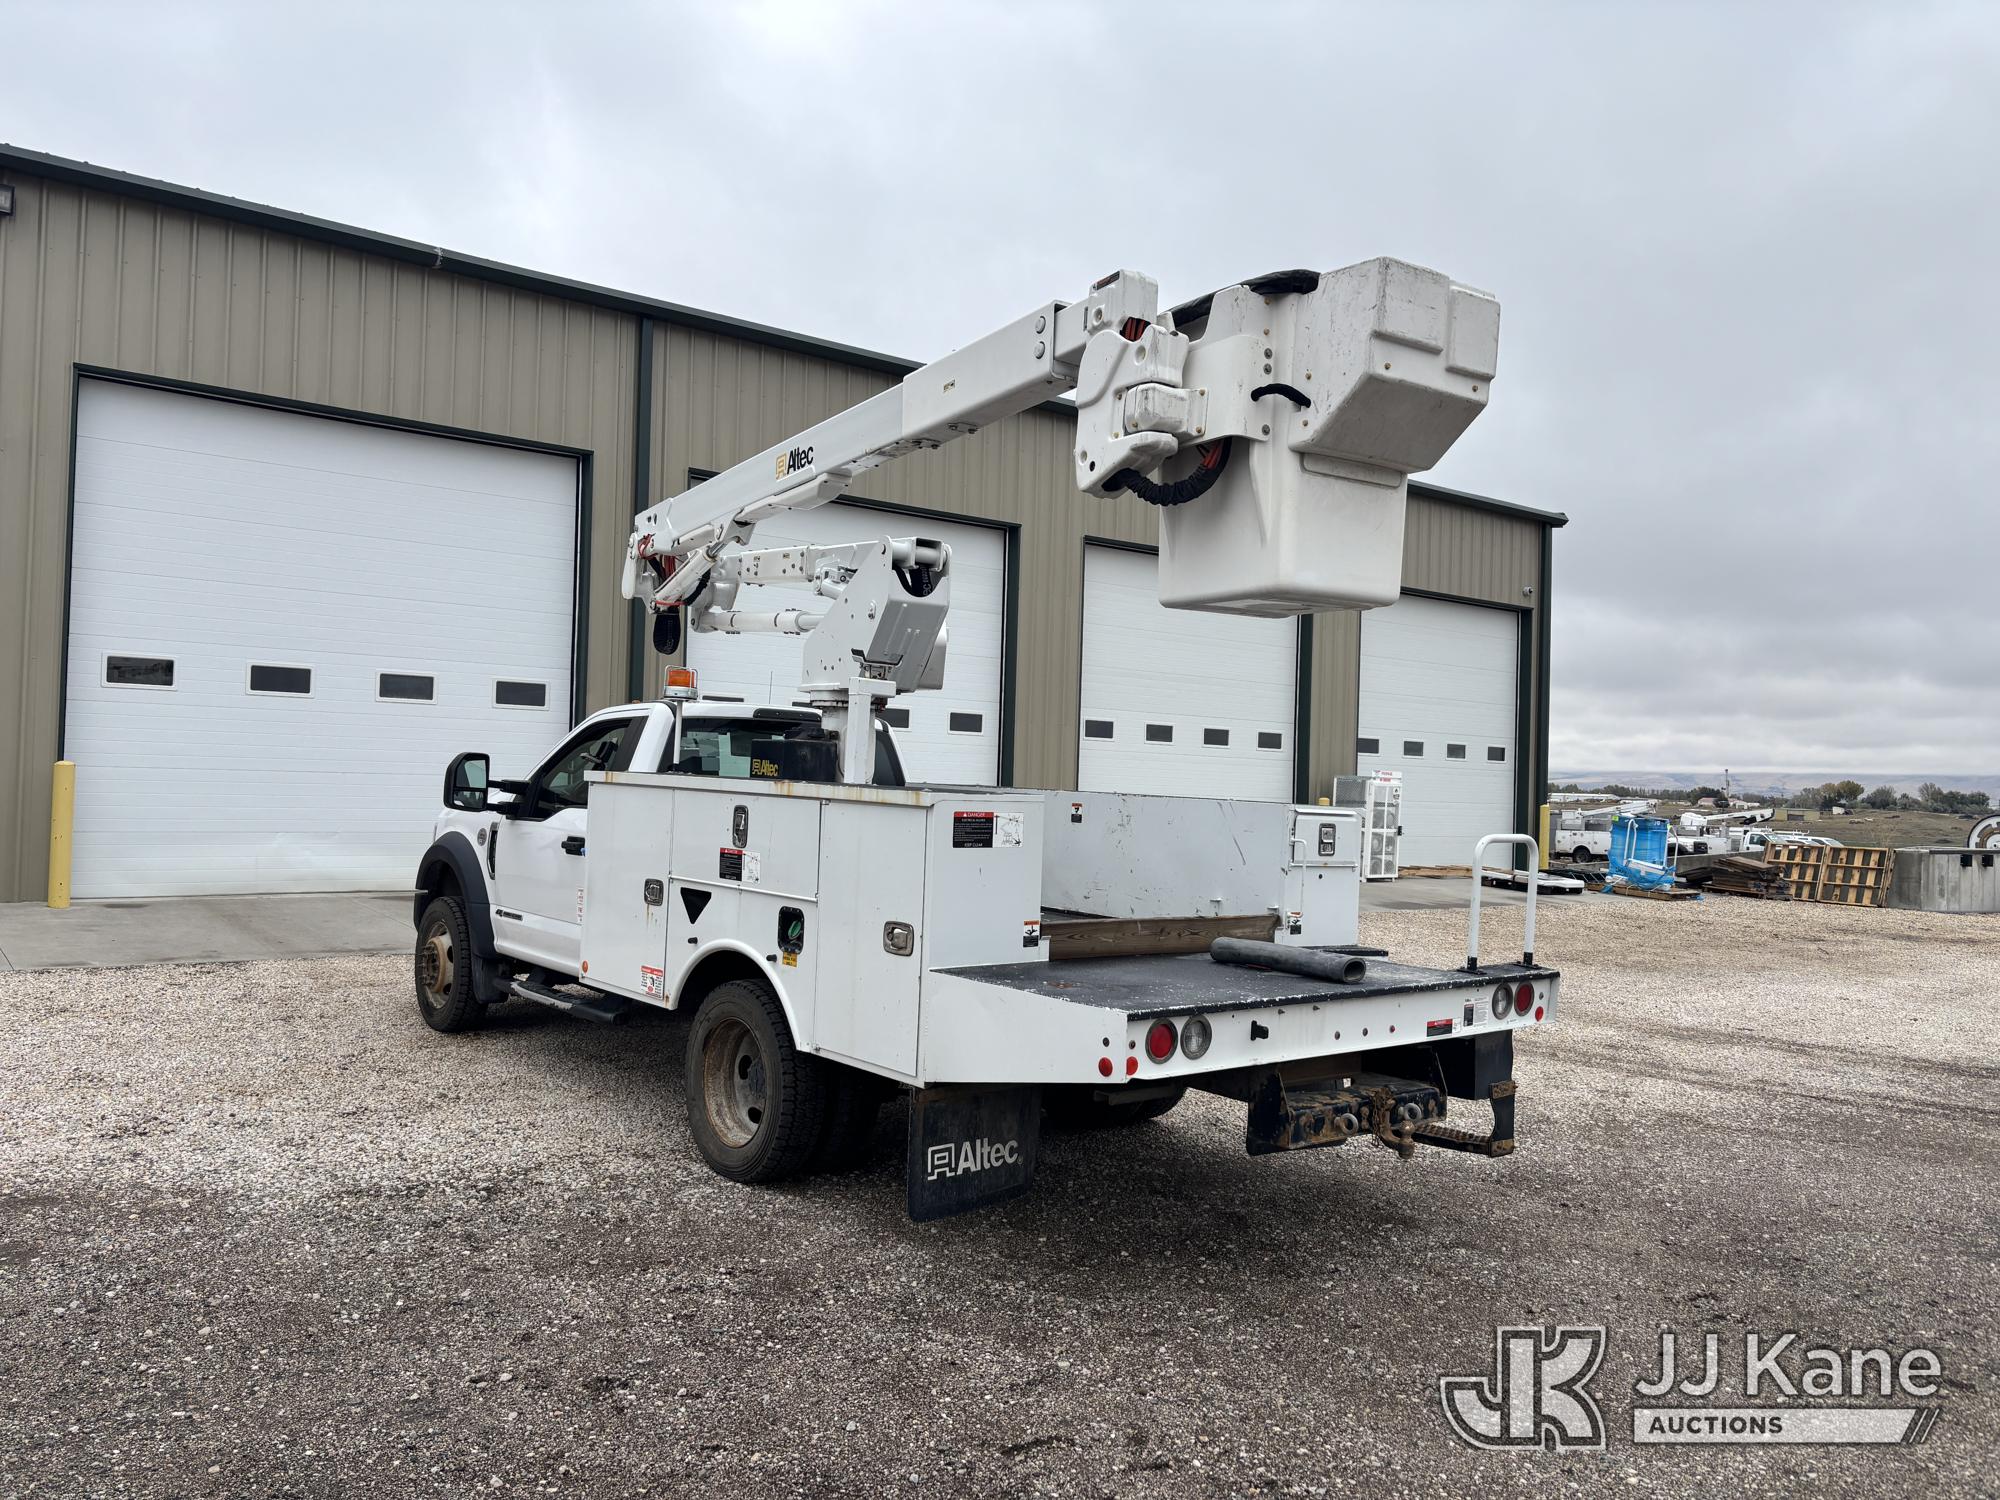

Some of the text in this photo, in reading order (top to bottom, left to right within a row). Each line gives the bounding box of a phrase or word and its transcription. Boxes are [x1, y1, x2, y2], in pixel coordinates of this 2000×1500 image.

[787, 446, 814, 475] Altec
[760, 759, 779, 777] Altec
[956, 1137, 1018, 1175] Altec
